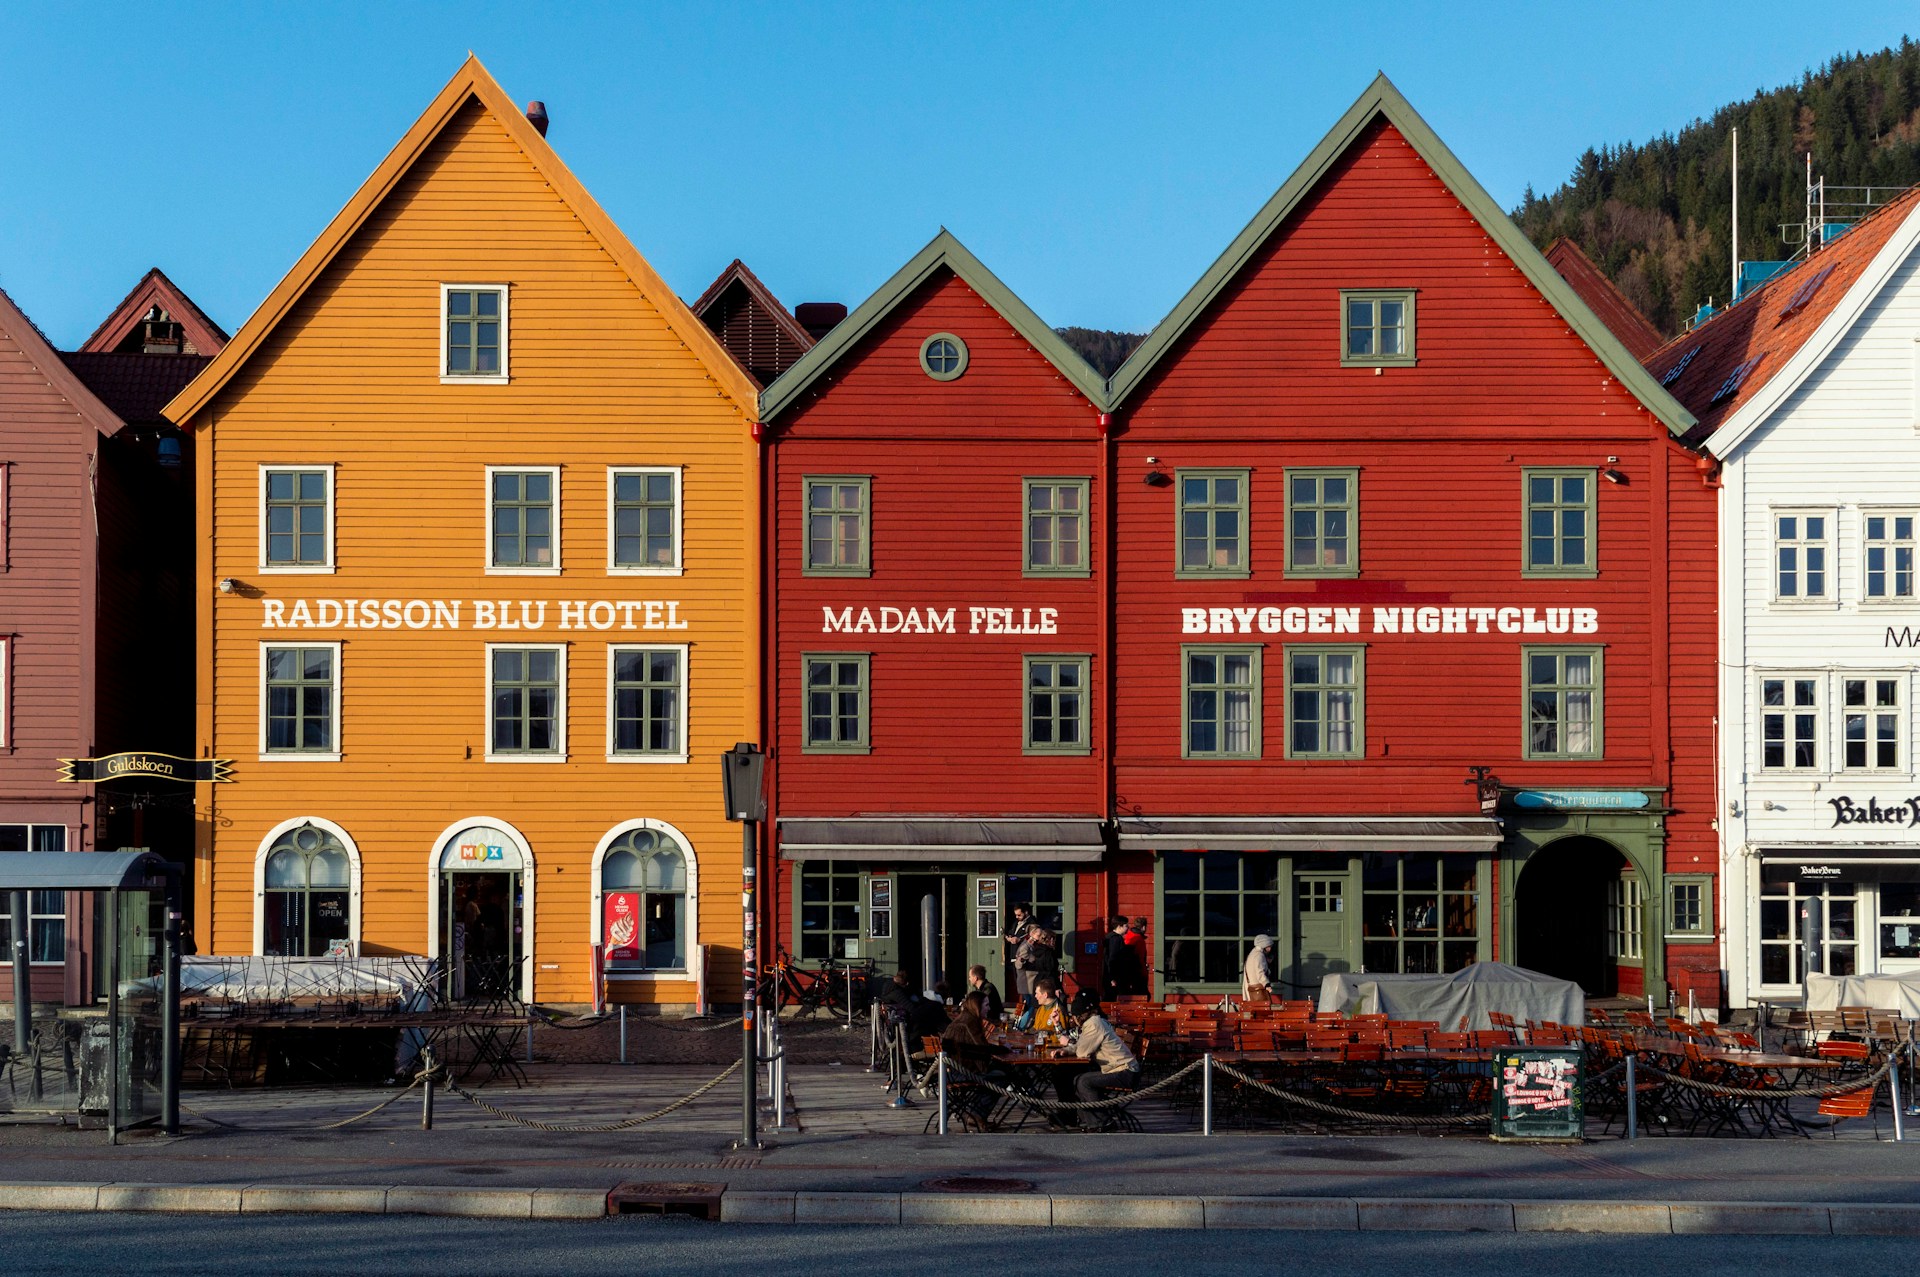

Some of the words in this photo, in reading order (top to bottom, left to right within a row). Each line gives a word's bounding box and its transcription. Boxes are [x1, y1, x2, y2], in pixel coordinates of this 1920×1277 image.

[262, 600, 462, 630] RADISSON
[473, 600, 547, 630] BLU
[558, 600, 688, 630] HOTEL
[823, 607, 956, 634] MADAM
[969, 606, 1058, 634] FELLE
[1181, 606, 1361, 634] BRYGGEN
[1373, 606, 1599, 634] NIGHTCLUB
[107, 757, 173, 774] Guldskoen
[463, 846, 500, 858] MIX
[319, 909, 342, 917] OPEN
